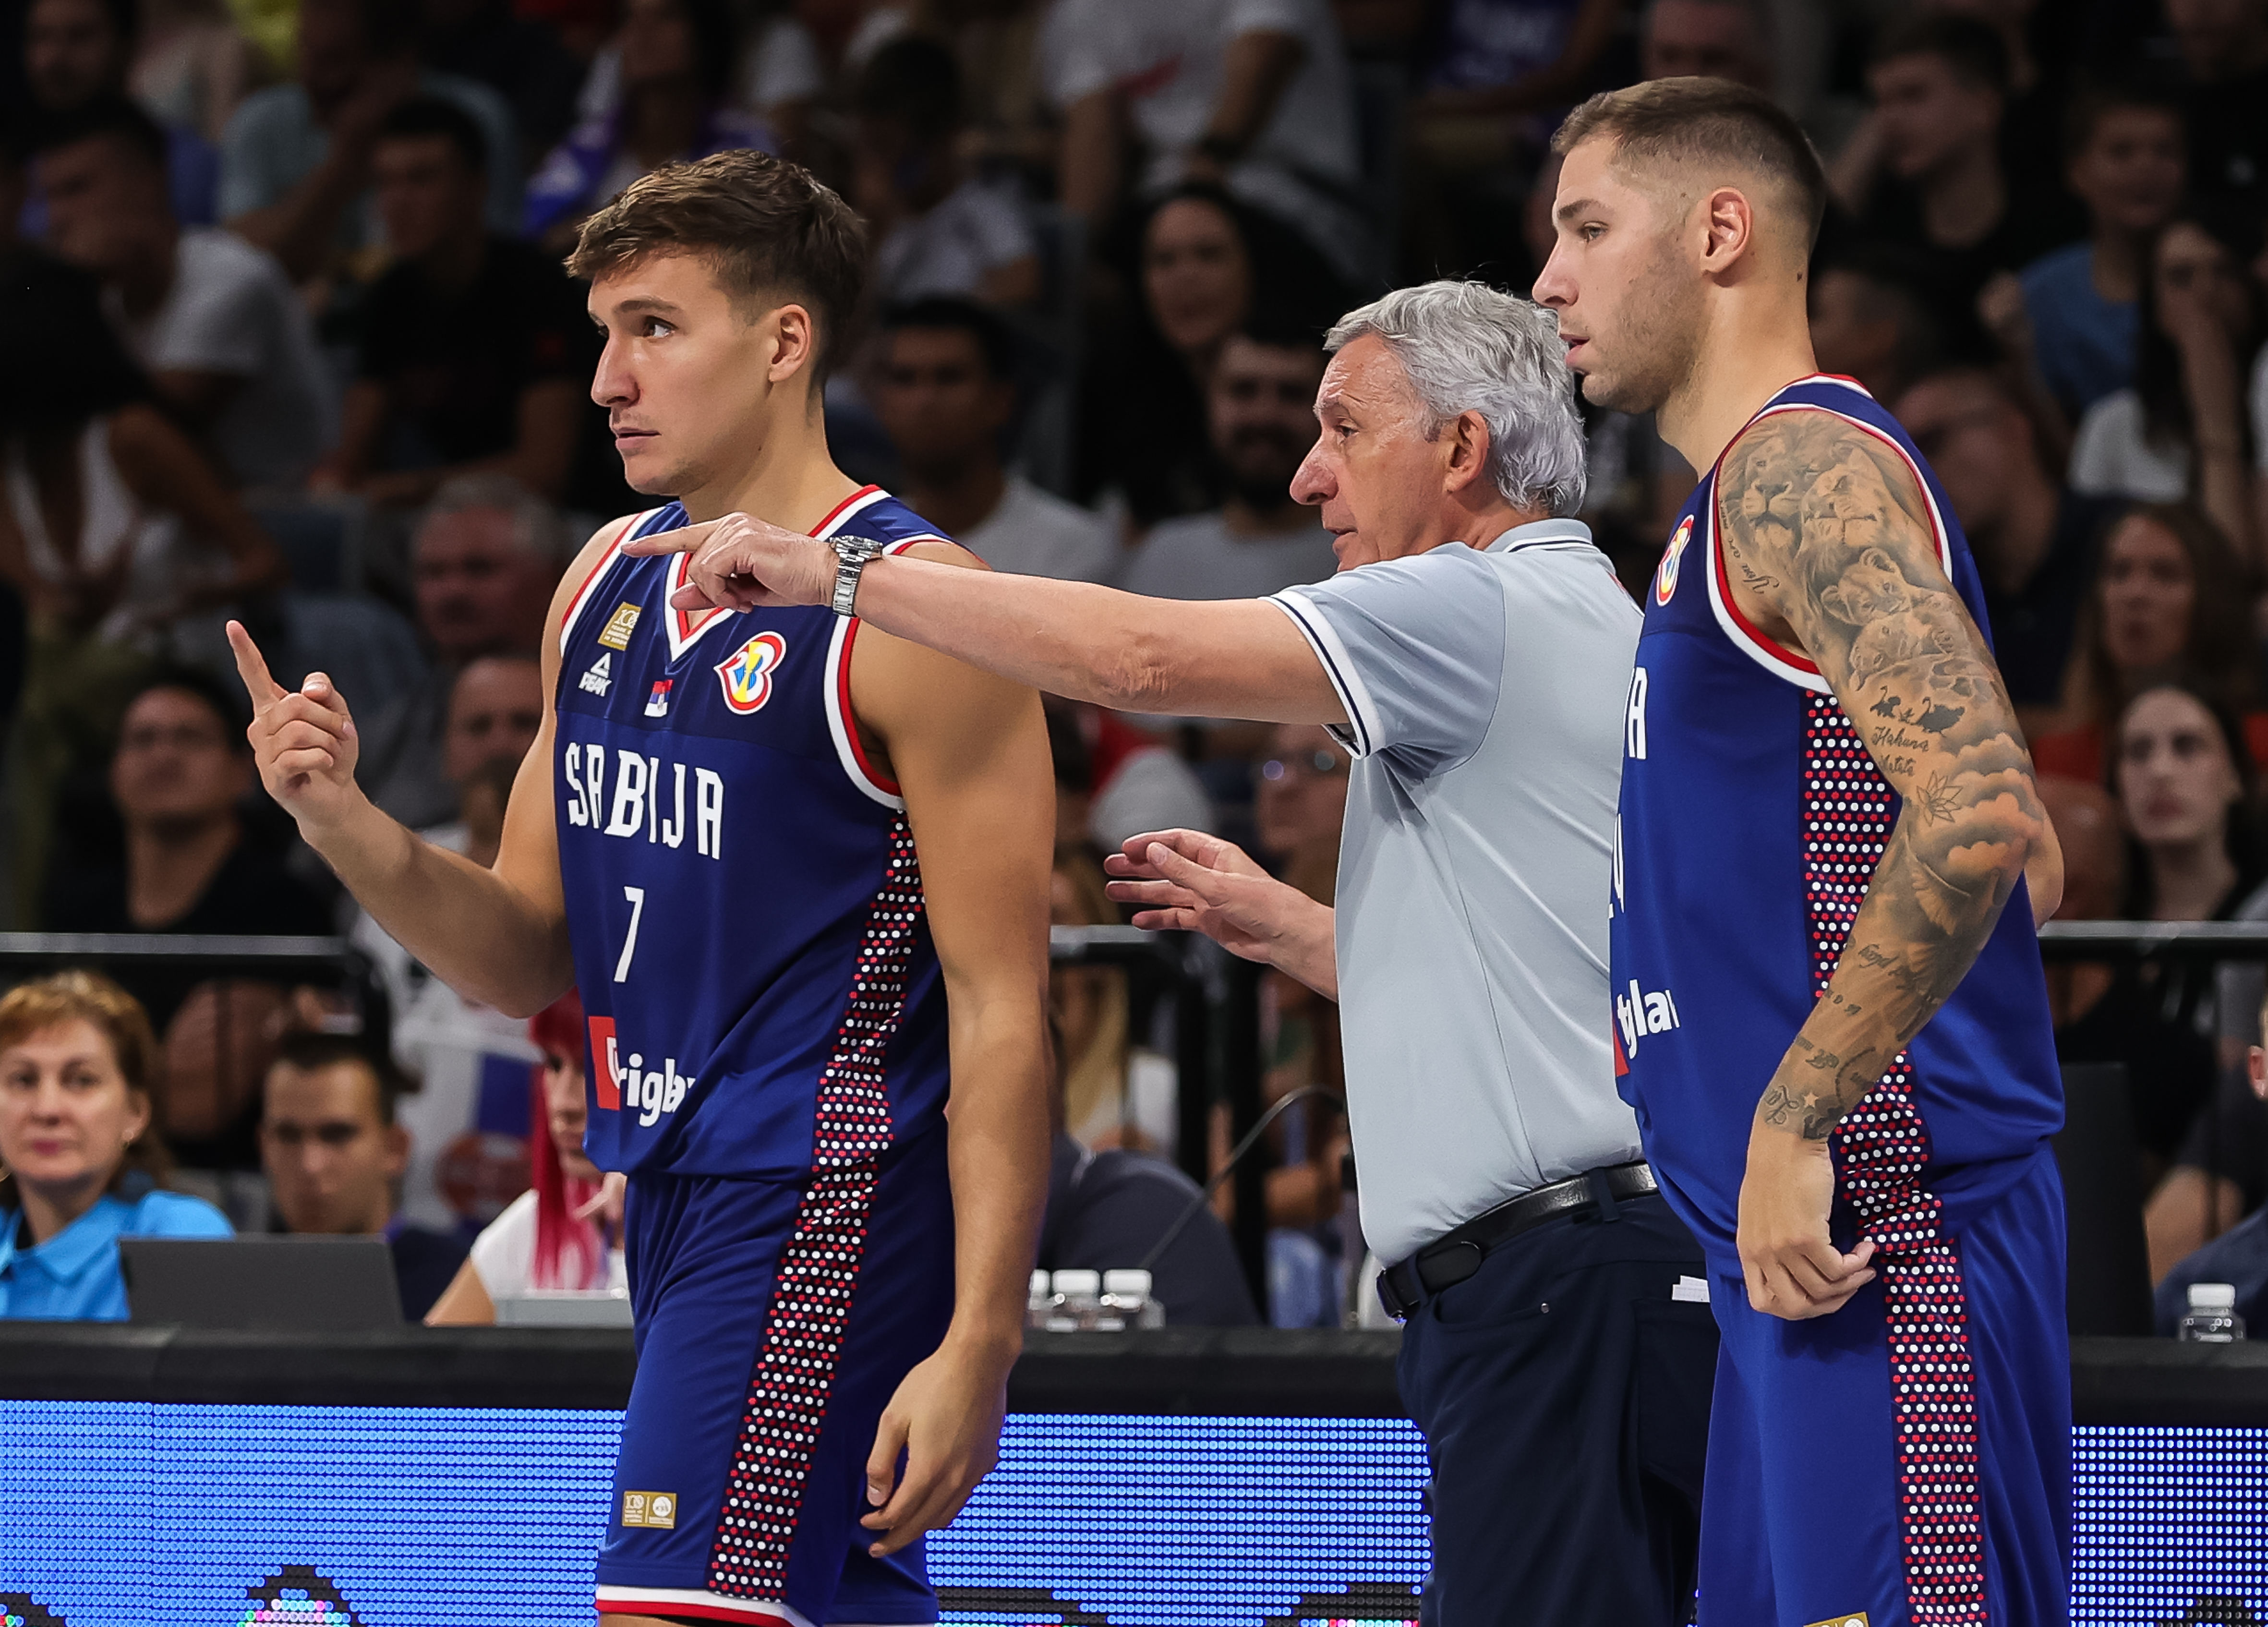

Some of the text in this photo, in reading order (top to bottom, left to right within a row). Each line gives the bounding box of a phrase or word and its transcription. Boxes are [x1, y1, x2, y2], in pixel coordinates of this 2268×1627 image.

[578, 671, 612, 697] PEAK
[565, 742, 724, 860] SRBIJA
[614, 886, 645, 983] 7
